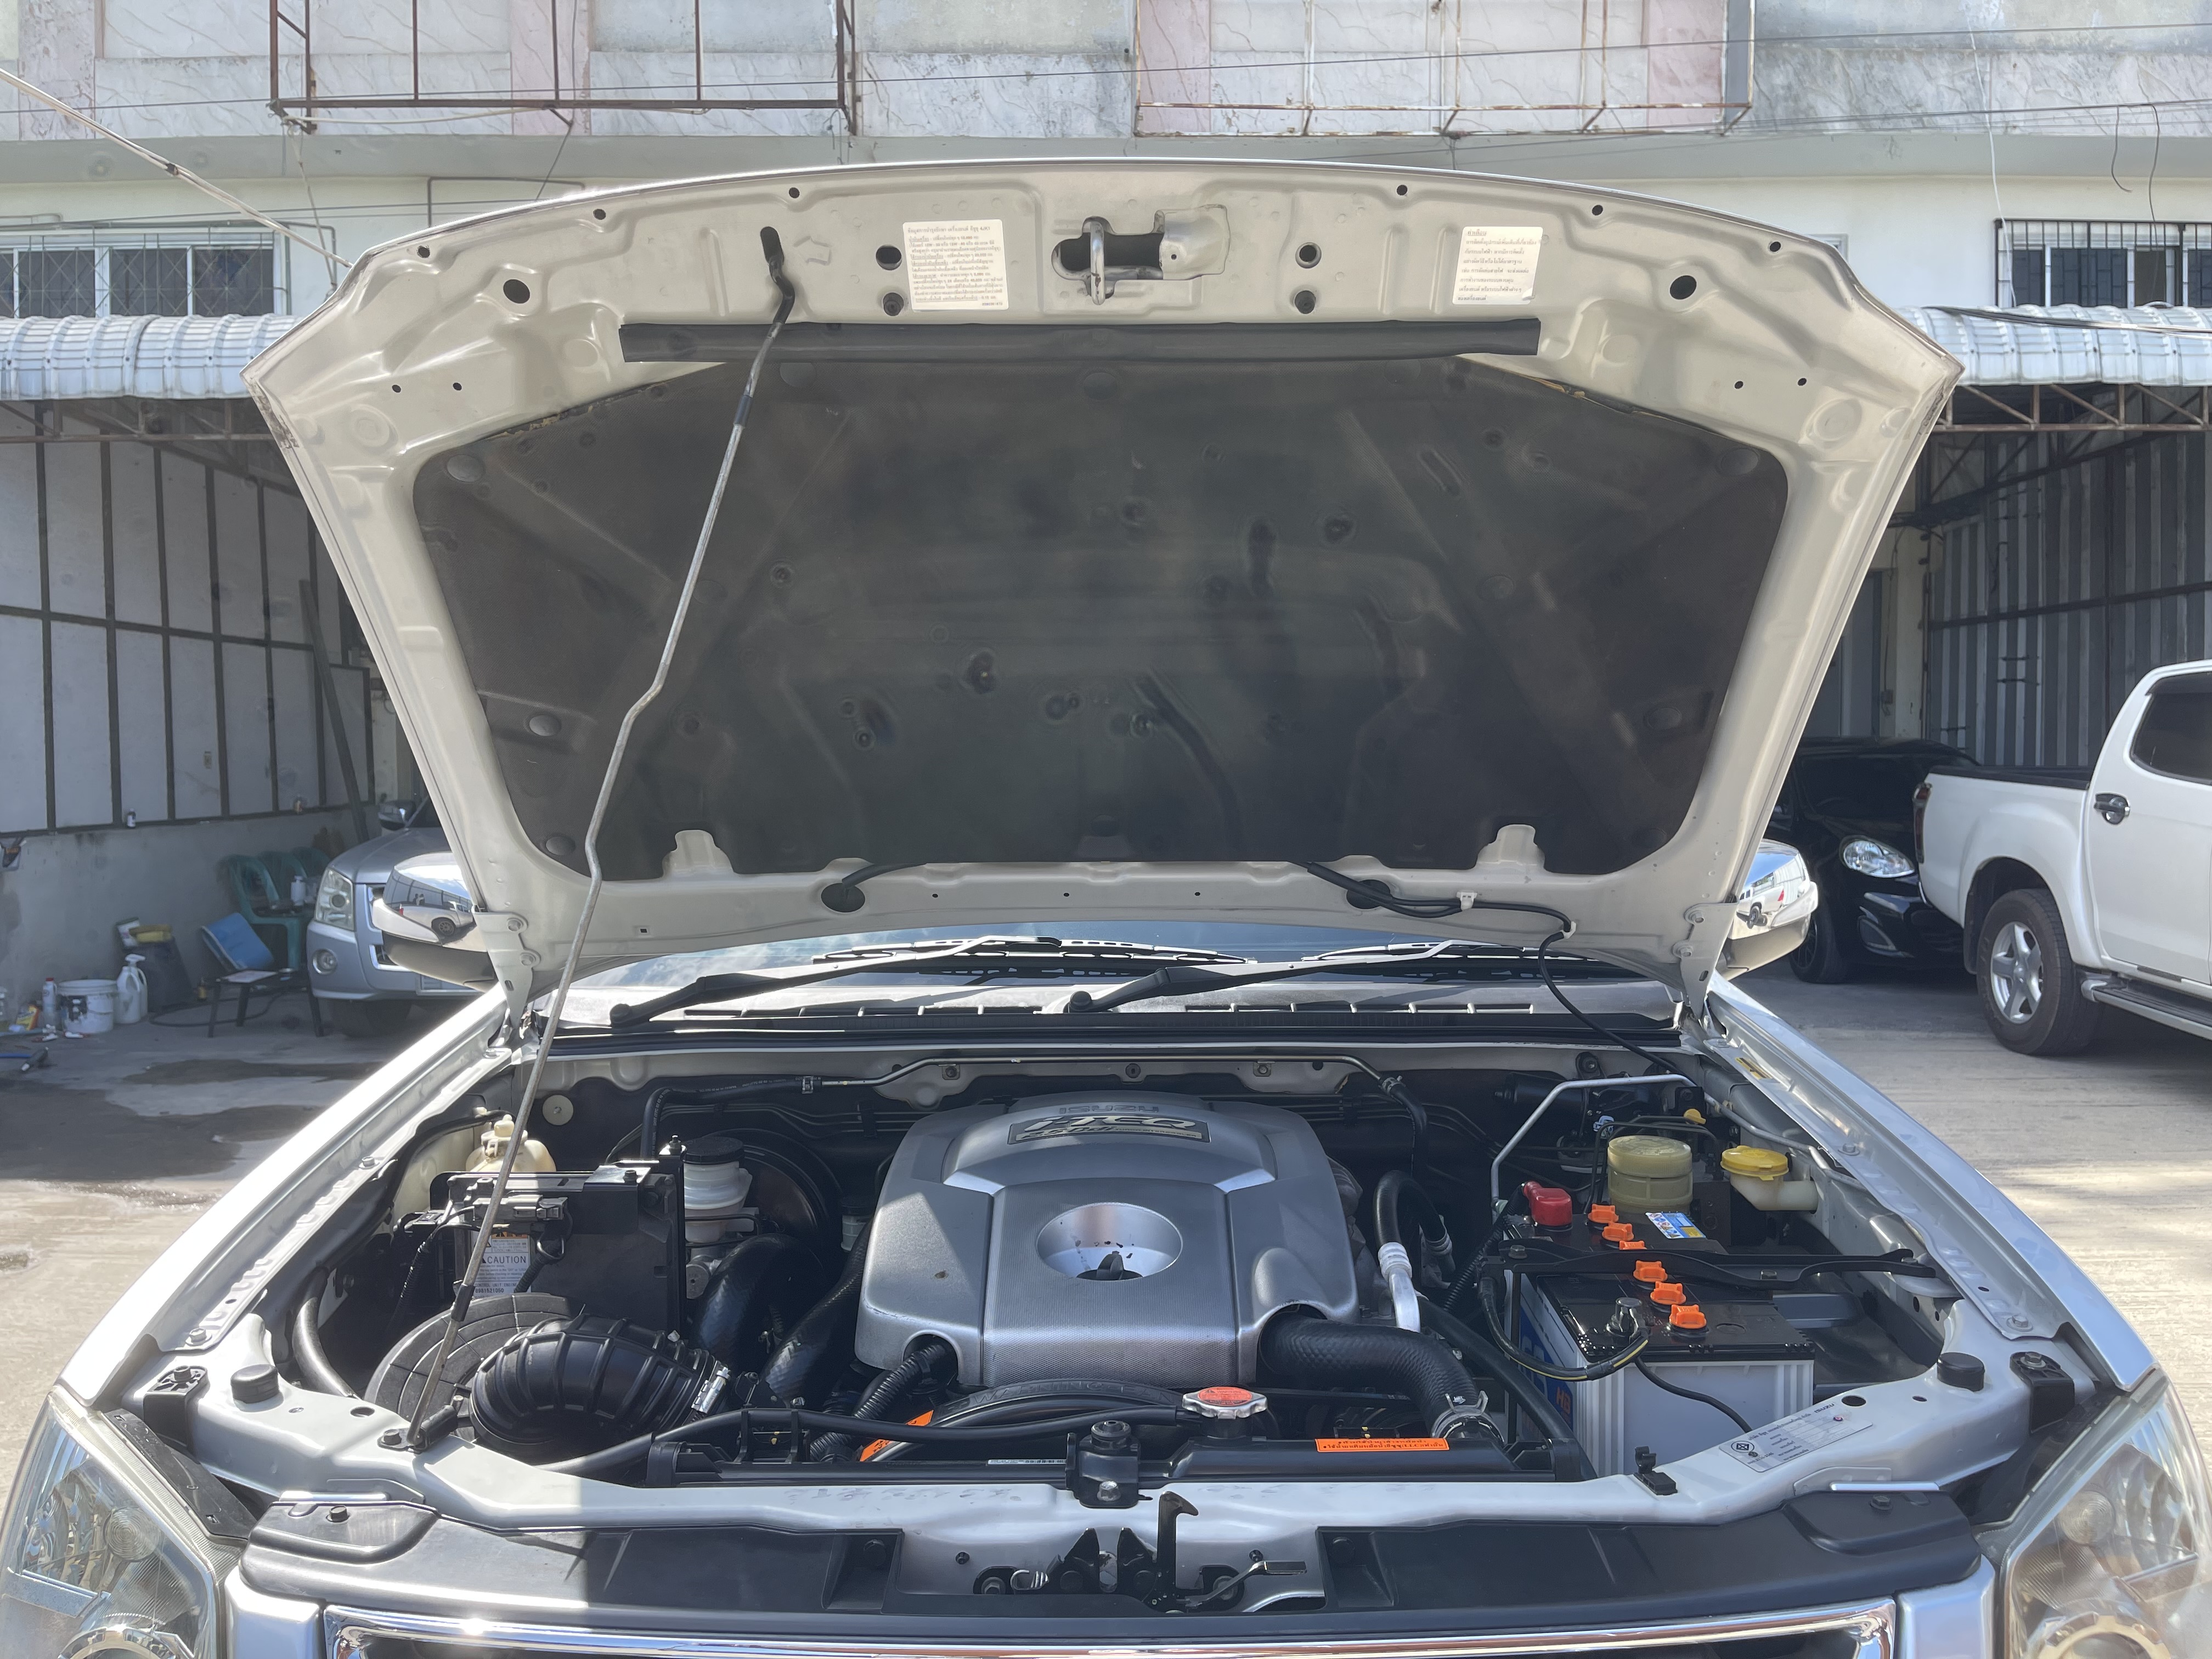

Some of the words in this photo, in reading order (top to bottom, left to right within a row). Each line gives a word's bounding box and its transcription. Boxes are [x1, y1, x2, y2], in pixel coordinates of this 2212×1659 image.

[1059, 1105, 1159, 1114] ISUZU
[1024, 1116, 1195, 1132] i-TEQ
[1813, 1403, 1835, 1414] ISUZU
